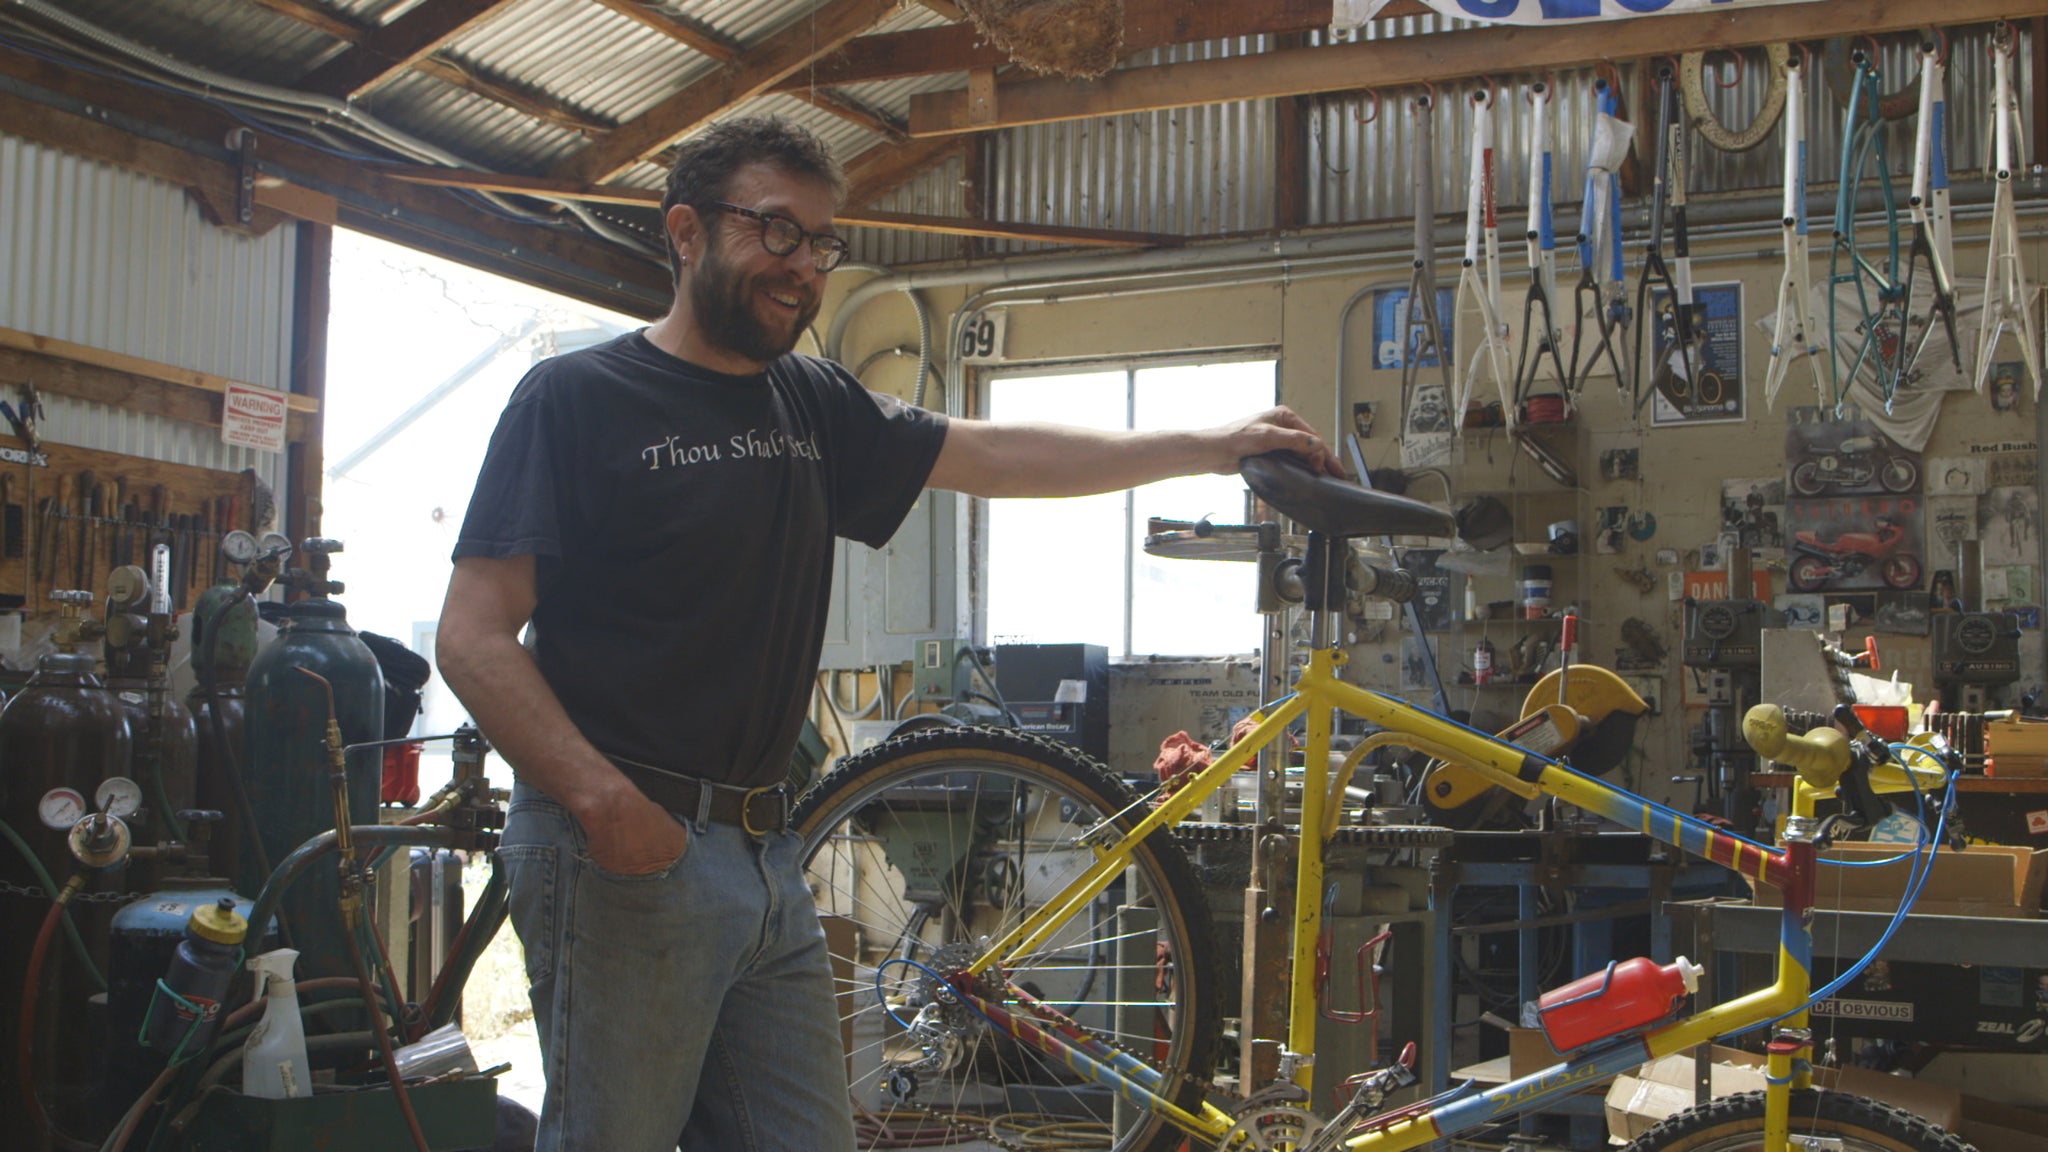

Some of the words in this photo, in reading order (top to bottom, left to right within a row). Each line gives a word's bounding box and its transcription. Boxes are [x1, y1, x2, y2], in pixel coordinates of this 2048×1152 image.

[231, 394, 281, 415] WARNING
[642, 435, 722, 470] Thou
[730, 428, 784, 459] Shalt
[1970, 444, 1999, 453] Red
[1843, 1003, 1910, 1018] OBVIOUS
[1976, 1020, 2016, 1034] ZEAL
